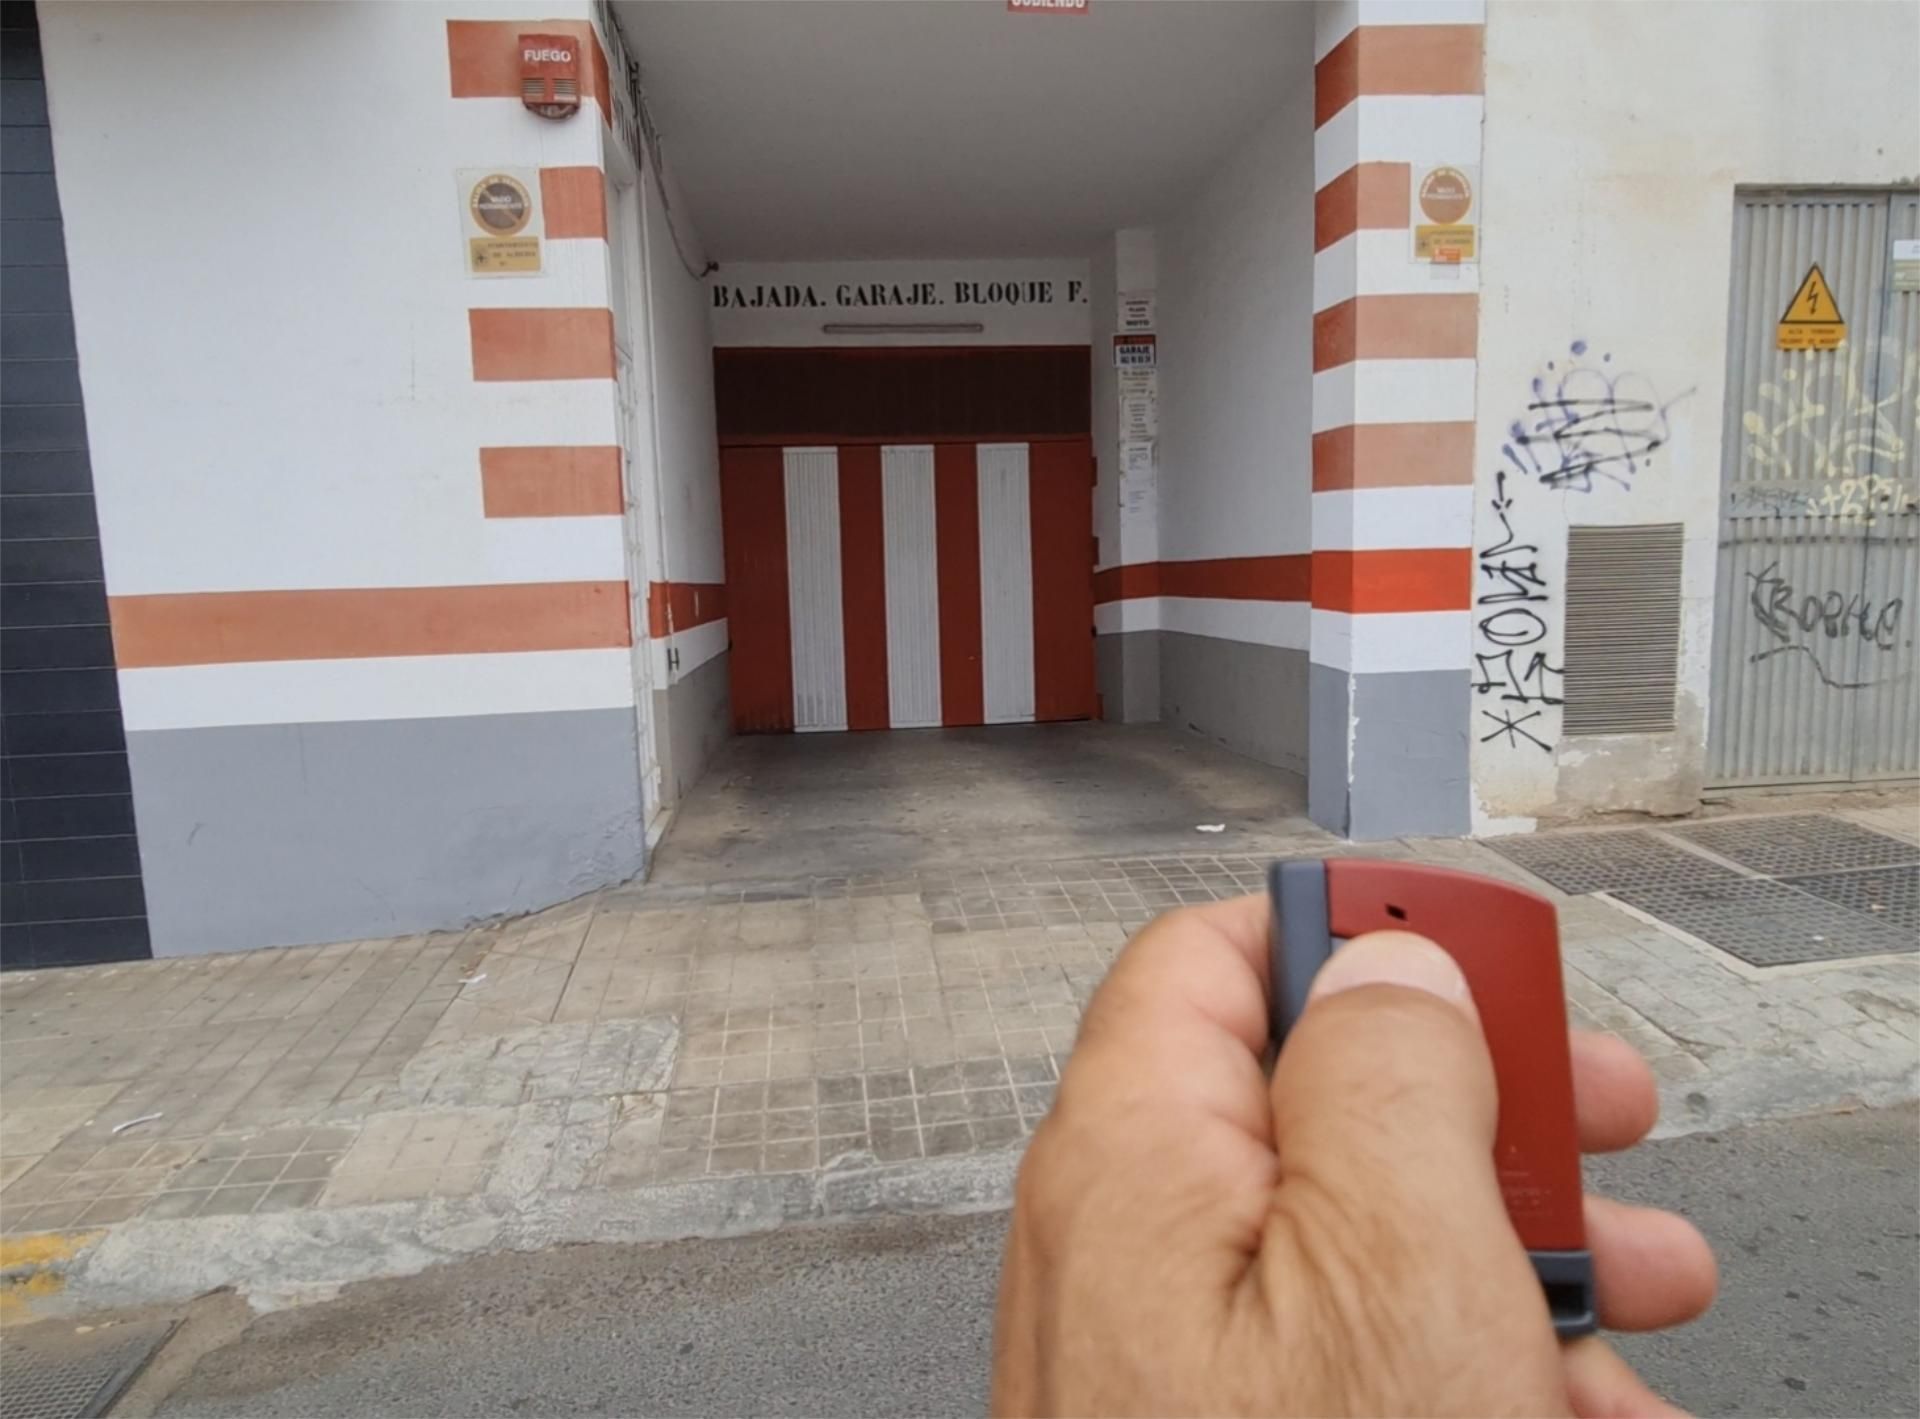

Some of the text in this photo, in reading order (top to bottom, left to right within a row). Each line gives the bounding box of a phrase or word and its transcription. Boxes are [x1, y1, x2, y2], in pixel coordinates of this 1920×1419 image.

[523, 49, 572, 63] FUEGO
[712, 280, 1089, 308] BAJADA. GARAJE. BLOQUE F.
